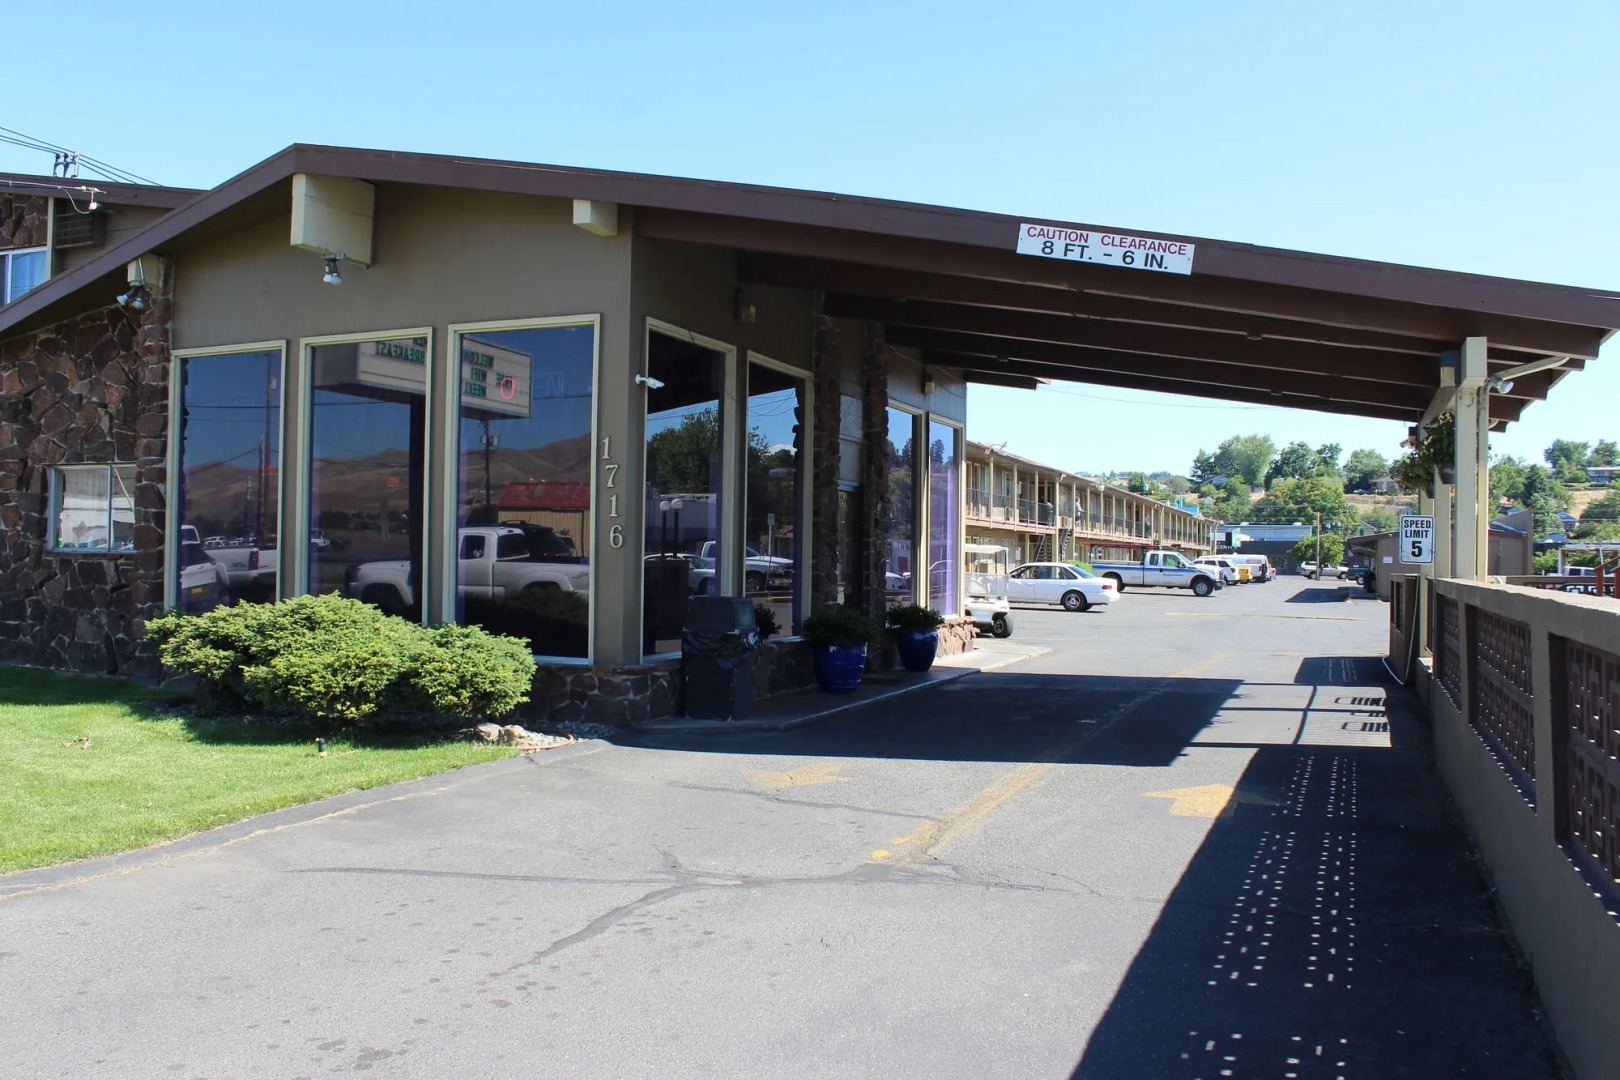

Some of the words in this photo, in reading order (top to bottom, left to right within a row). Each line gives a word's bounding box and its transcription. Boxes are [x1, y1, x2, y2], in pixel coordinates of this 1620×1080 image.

[1026, 226, 1089, 244] CAUTION
[1100, 234, 1188, 256] CLEARANCE
[1041, 240, 1054, 255] 8
[1063, 242, 1093, 260] FT.
[1122, 250, 1135, 266] 6
[1143, 252, 1168, 270] IN.
[601, 435, 623, 549] 1716
[1403, 519, 1431, 529] SPEED
[1404, 529, 1429, 539] LIMIT
[1411, 540, 1423, 558] 5
